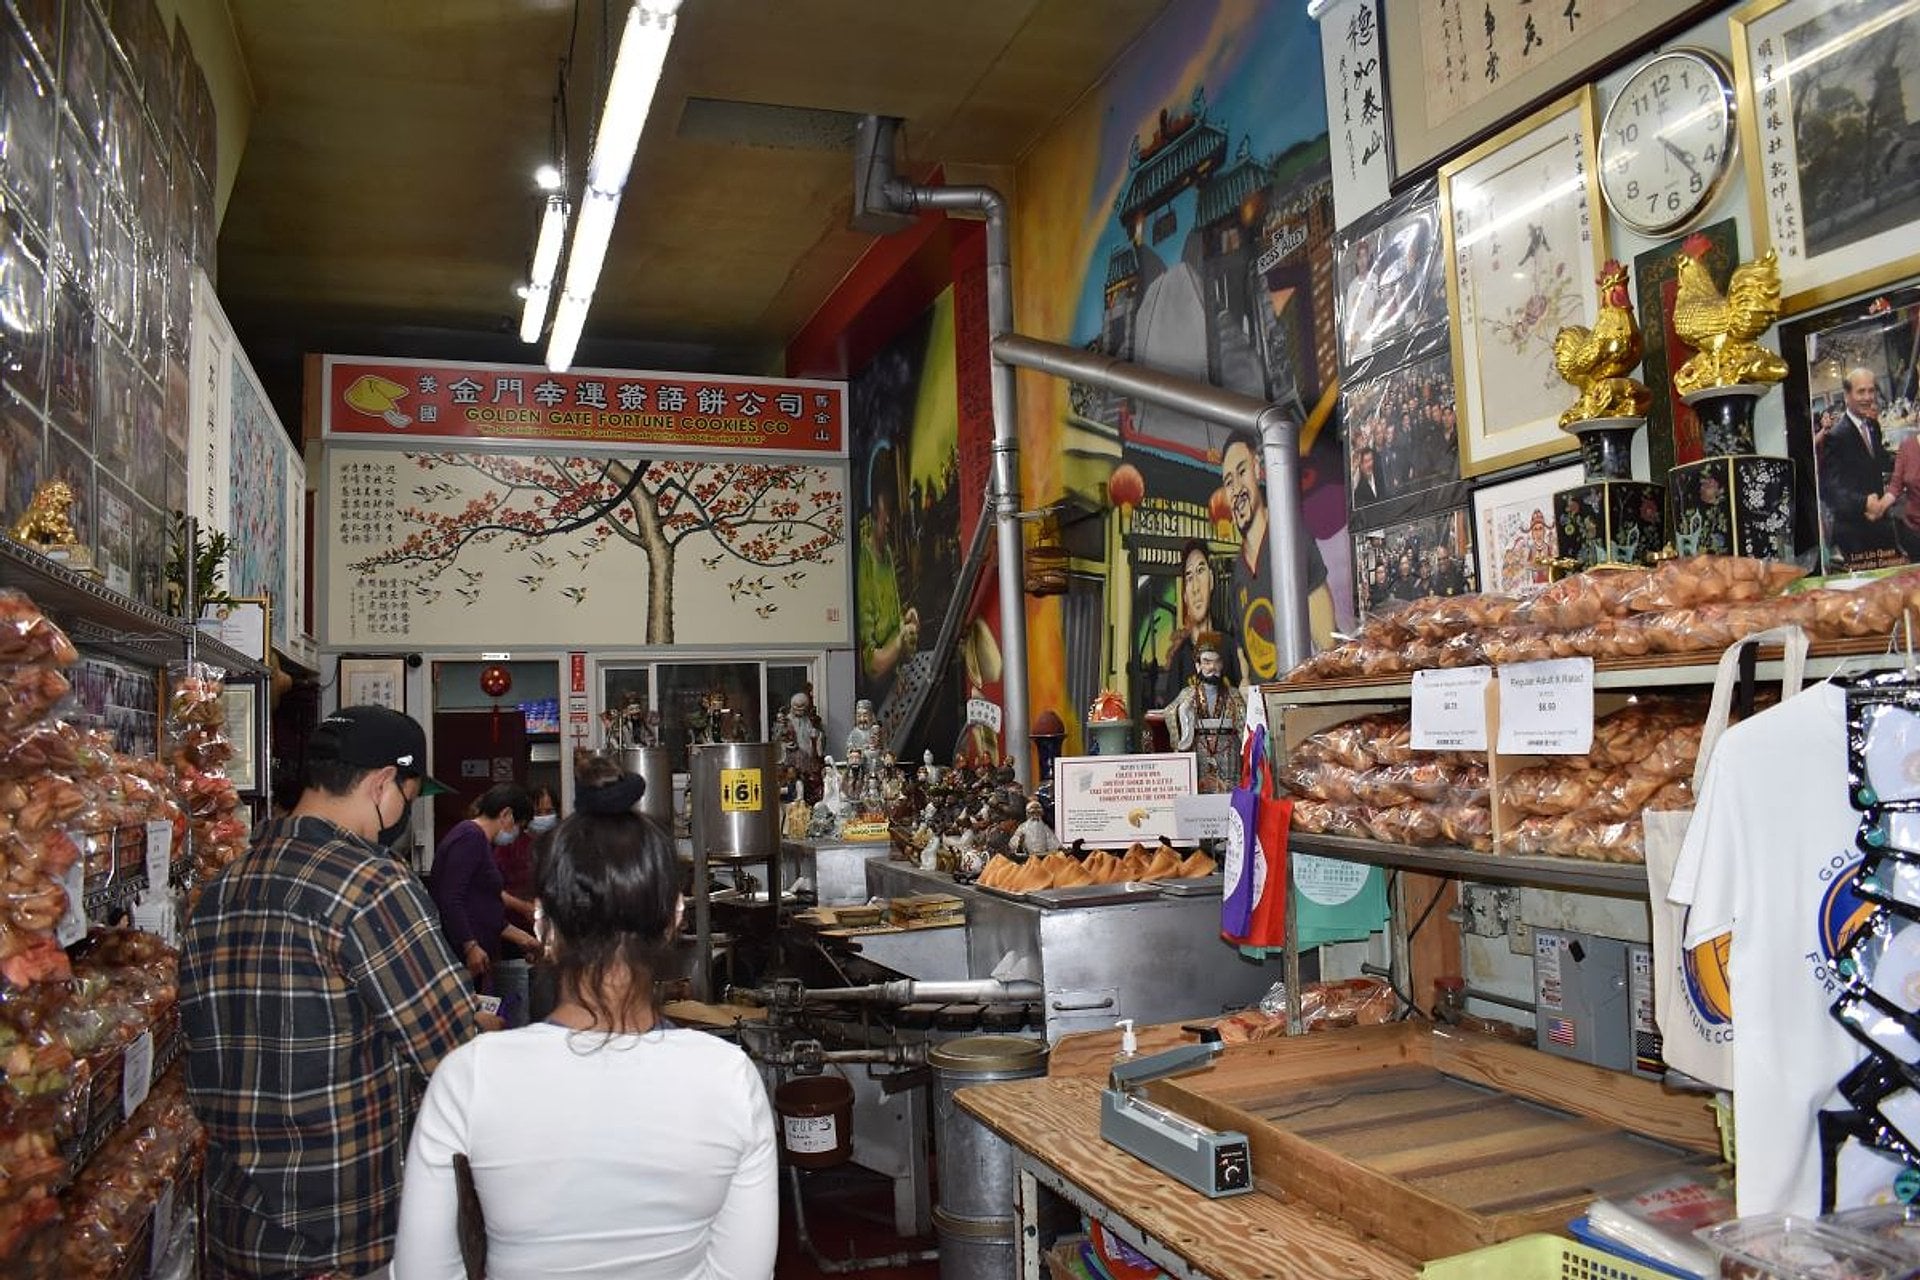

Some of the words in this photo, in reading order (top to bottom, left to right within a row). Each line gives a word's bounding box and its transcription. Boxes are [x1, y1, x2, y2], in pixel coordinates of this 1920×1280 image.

[1651, 74, 1671, 98] 12
[1681, 71, 1689, 89] 1
[1698, 84, 1710, 105] 2
[1632, 94, 1649, 116] 11
[1707, 112, 1721, 131] 3
[1616, 123, 1638, 145] 10
[1704, 144, 1717, 163] 4
[1617, 155, 1629, 174] 9
[1627, 181, 1639, 200] 8
[1690, 173, 1703, 193] 5
[1647, 193, 1659, 213] 7
[1667, 192, 1680, 211] 6
[465, 407, 542, 424] GOLDEN
[549, 410, 592, 426] GATE
[599, 411, 674, 429] FORTUNE
[681, 416, 757, 433] COOKIES
[762, 419, 790, 434] CO
[735, 784, 749, 801] 6
[1818, 848, 1859, 883] GOL
